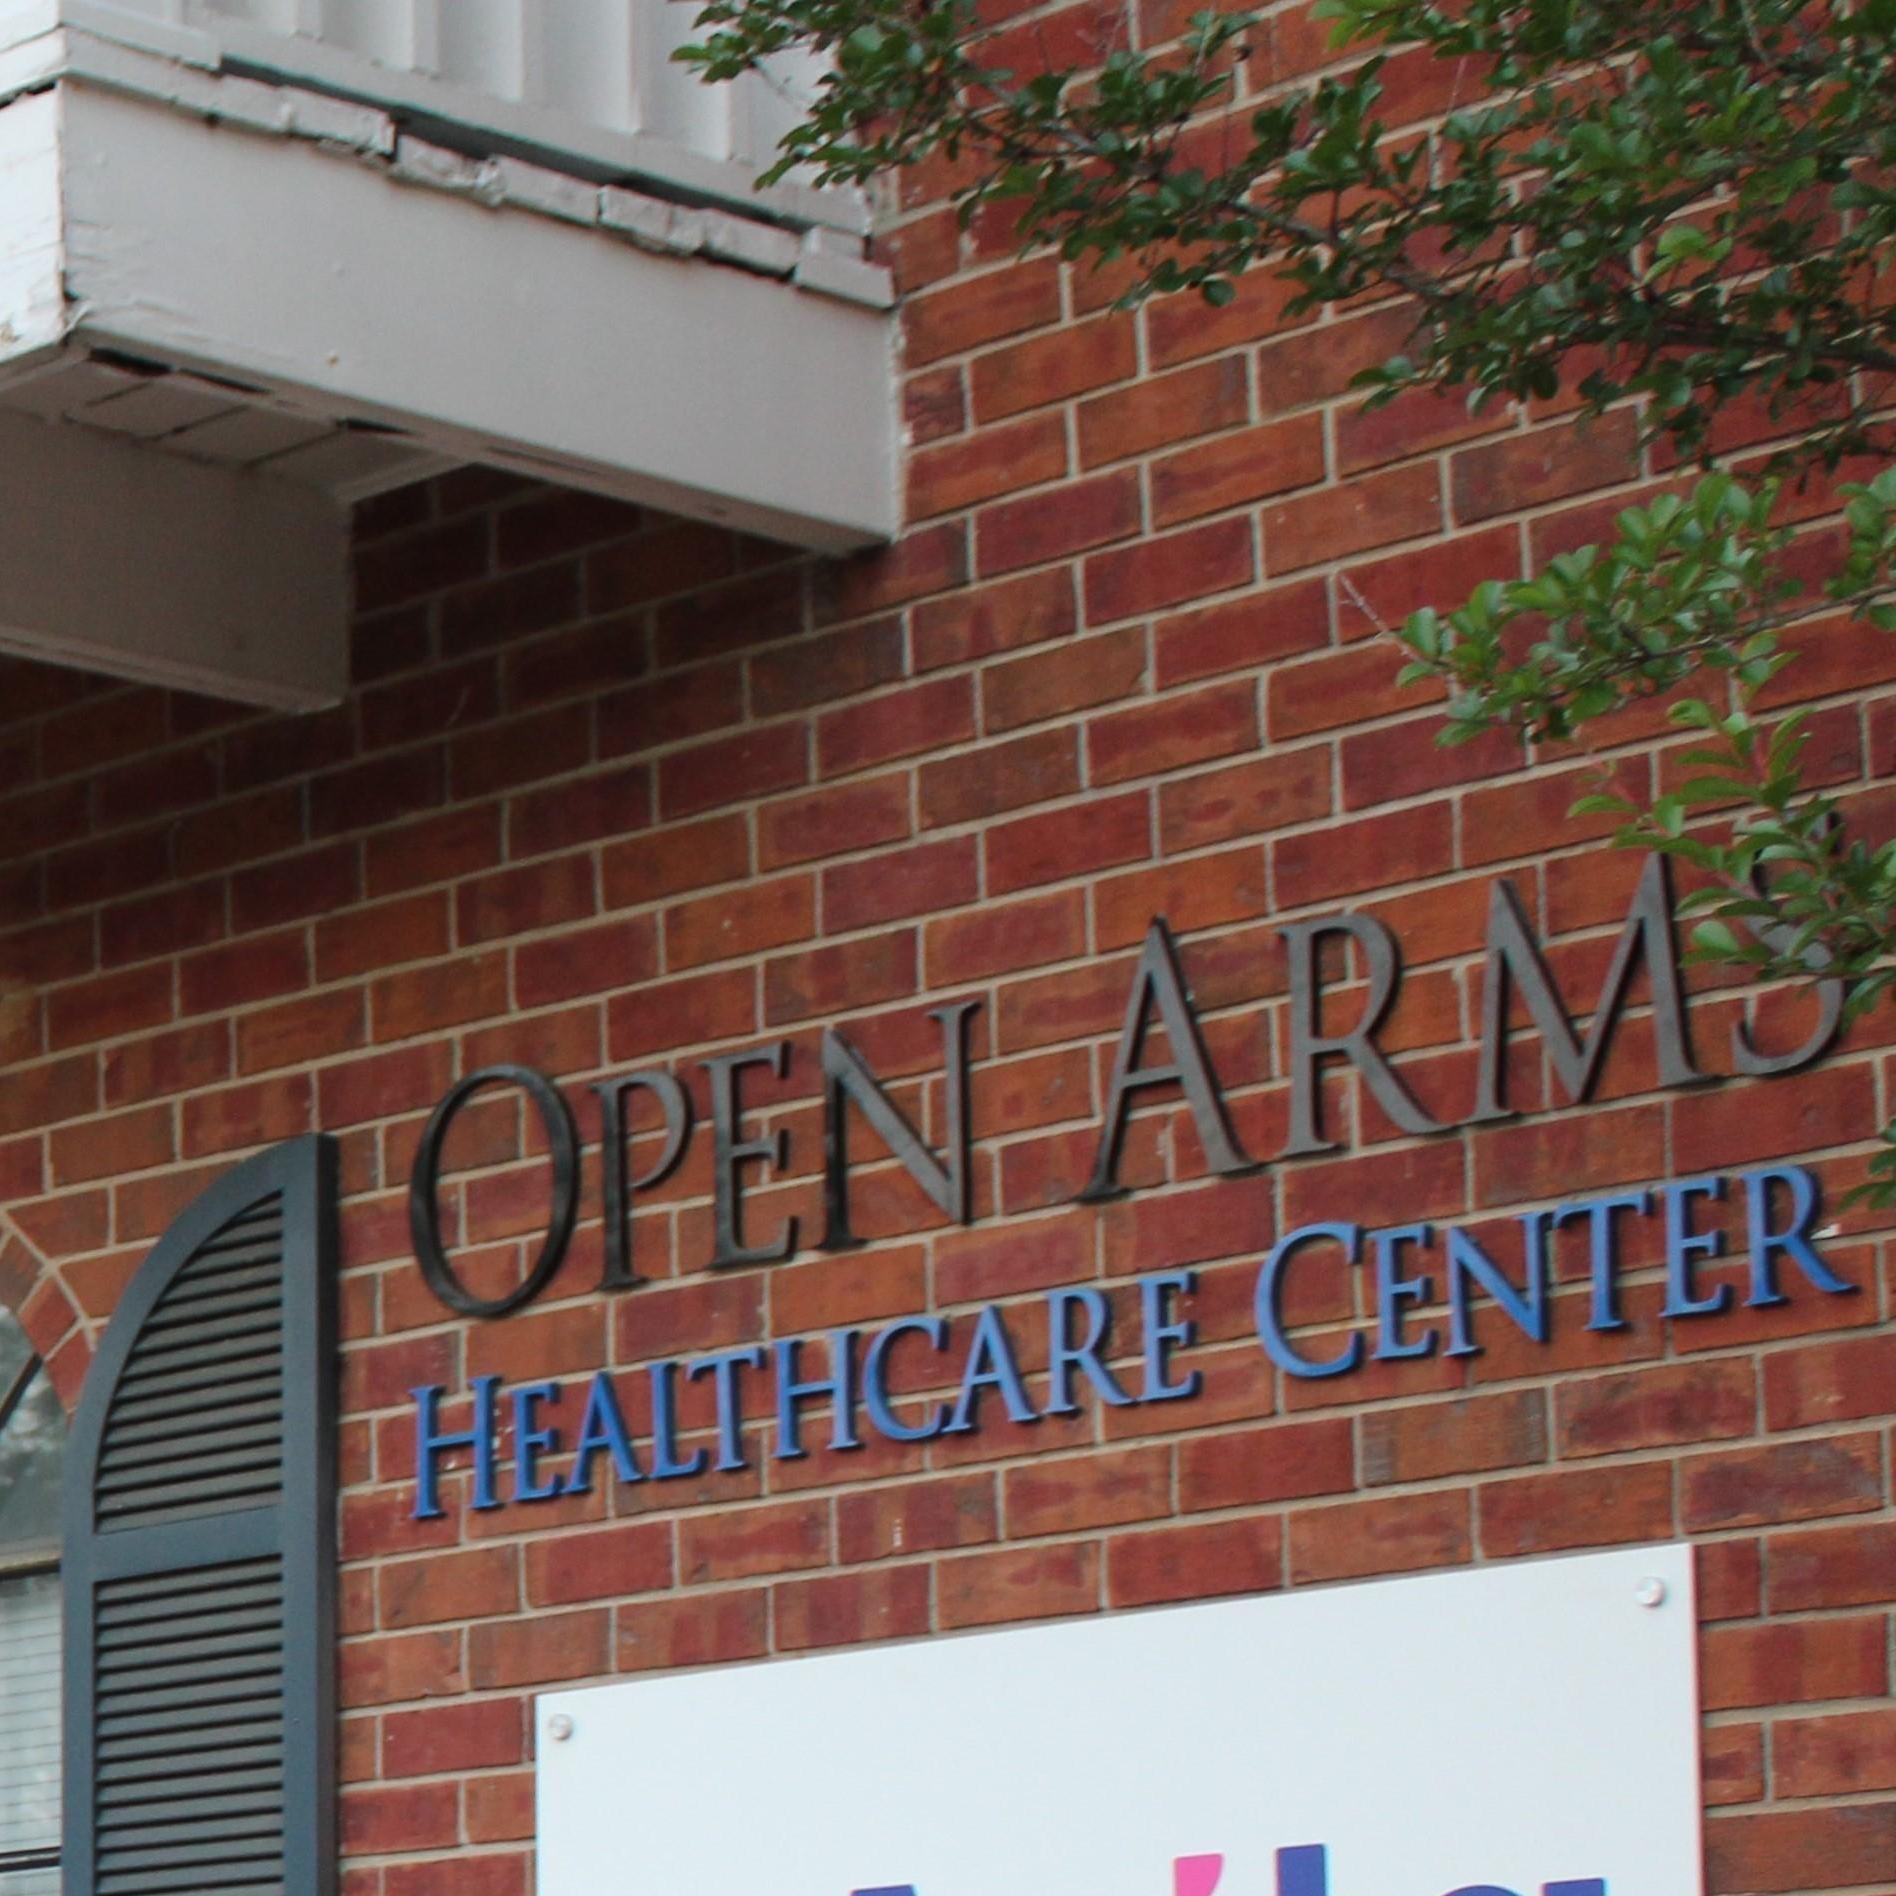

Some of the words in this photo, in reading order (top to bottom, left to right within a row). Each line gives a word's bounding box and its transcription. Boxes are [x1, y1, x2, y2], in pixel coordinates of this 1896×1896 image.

[410, 1000, 982, 1318] OPEN
[1081, 812, 1845, 1202] ARMS
[409, 1271, 1203, 1520] HEALTHCARE
[1254, 1165, 1860, 1379] CENTER
